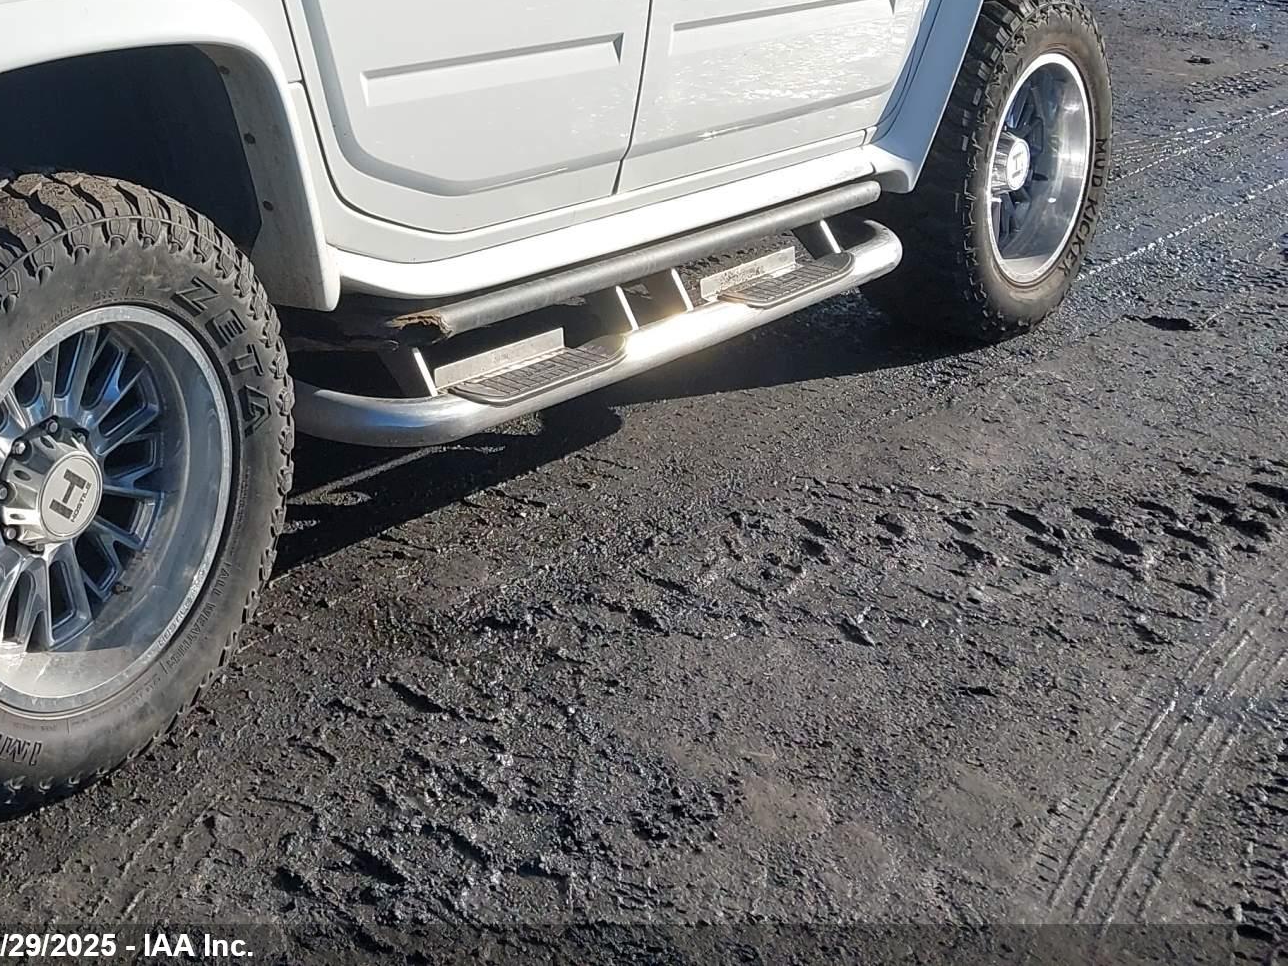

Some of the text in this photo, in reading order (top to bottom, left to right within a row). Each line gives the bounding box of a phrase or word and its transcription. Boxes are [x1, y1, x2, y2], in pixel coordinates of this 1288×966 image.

[1058, 138, 1108, 277] MUD KICKER
[170, 276, 272, 438] ZETA
[70, 481, 93, 523] HOSTILE
